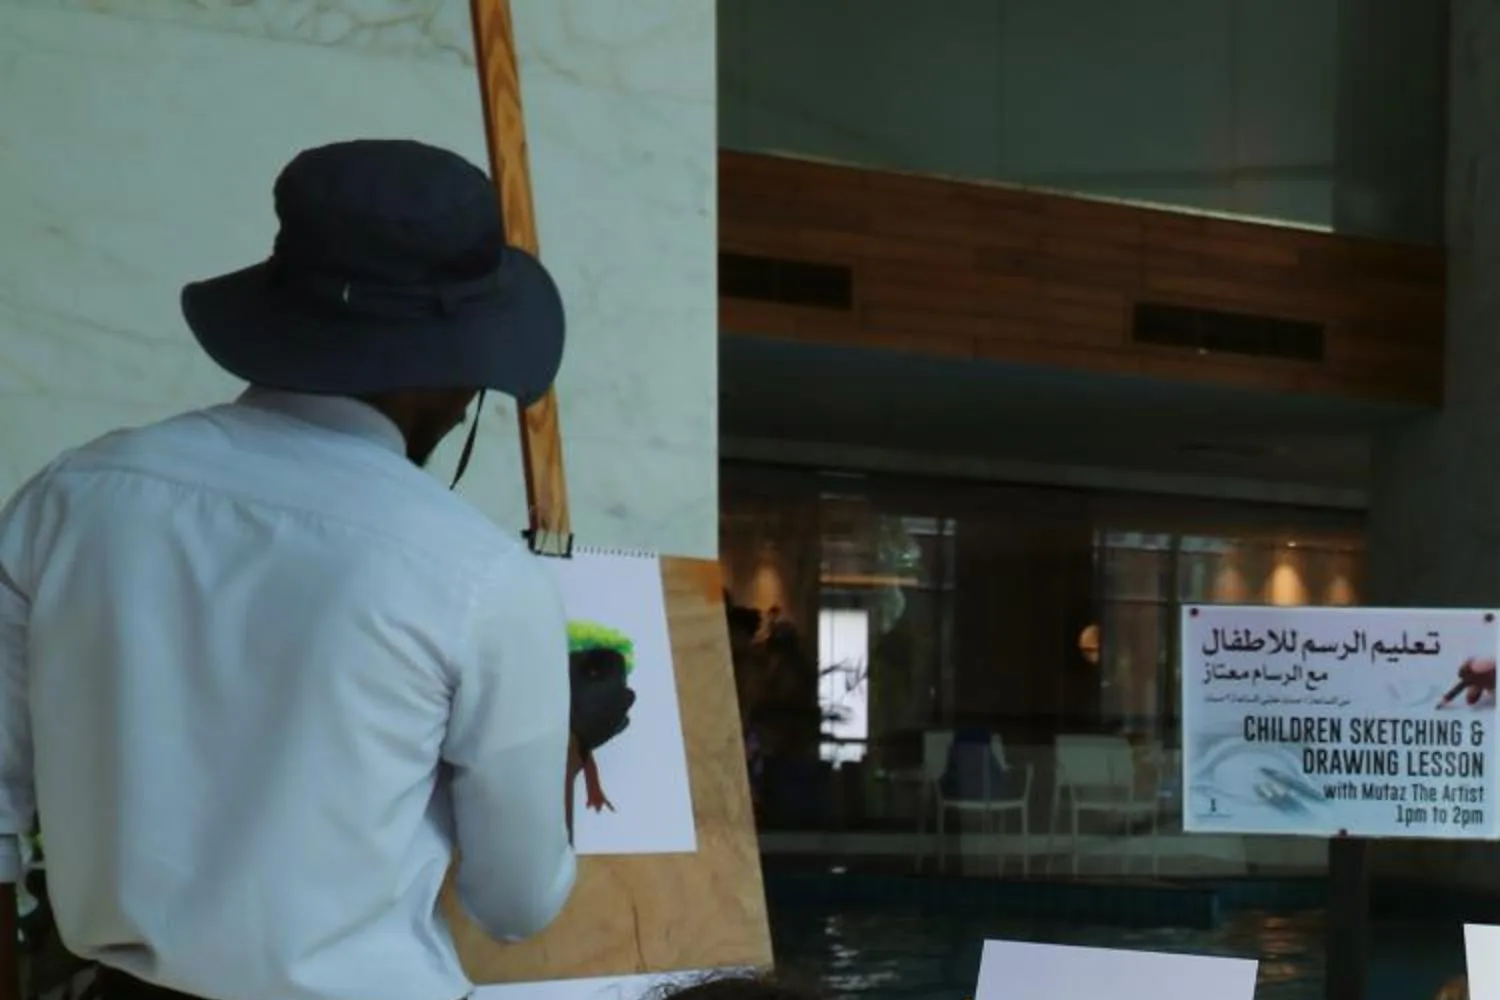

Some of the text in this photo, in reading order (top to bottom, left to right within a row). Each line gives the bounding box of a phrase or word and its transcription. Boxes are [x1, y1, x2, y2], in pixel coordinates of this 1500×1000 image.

[1201, 626, 1441, 662] تعليم الرسم للاطفال
[1252, 663, 1303, 687] الرسام
[1305, 670, 1328, 690] مع
[1243, 714, 1484, 746] CHILDREN SKETCHING &
[1302, 749, 1484, 778] DRAWING LESSON
[1323, 782, 1484, 802] with Mutaz The Artist
[1396, 805, 1484, 826] 1pm to 2pm
